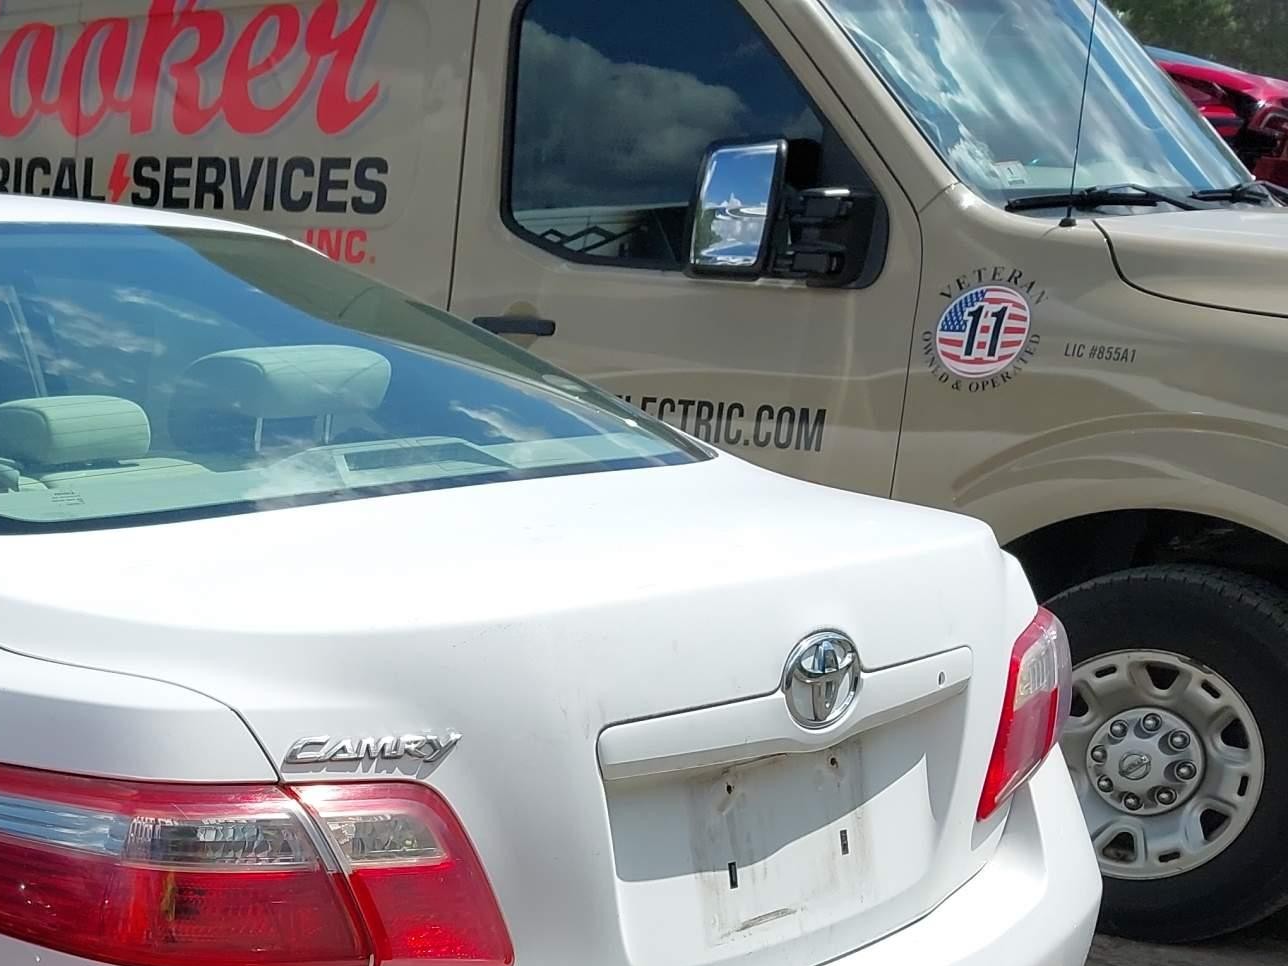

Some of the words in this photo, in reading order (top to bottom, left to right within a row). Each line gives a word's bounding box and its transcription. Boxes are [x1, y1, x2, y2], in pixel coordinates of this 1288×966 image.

[131, 156, 389, 215] SERVICES
[939, 265, 1048, 305] VETERAN
[963, 304, 1009, 358] 11
[1064, 343, 1086, 358] LIC
[1088, 344, 1137, 363] #855A1
[922, 329, 950, 384] OWNED
[950, 379, 962, 392] &
[967, 333, 1042, 393] OPERATED
[615, 394, 827, 453] CTRIC.COM
[285, 731, 462, 764] CAMRY
